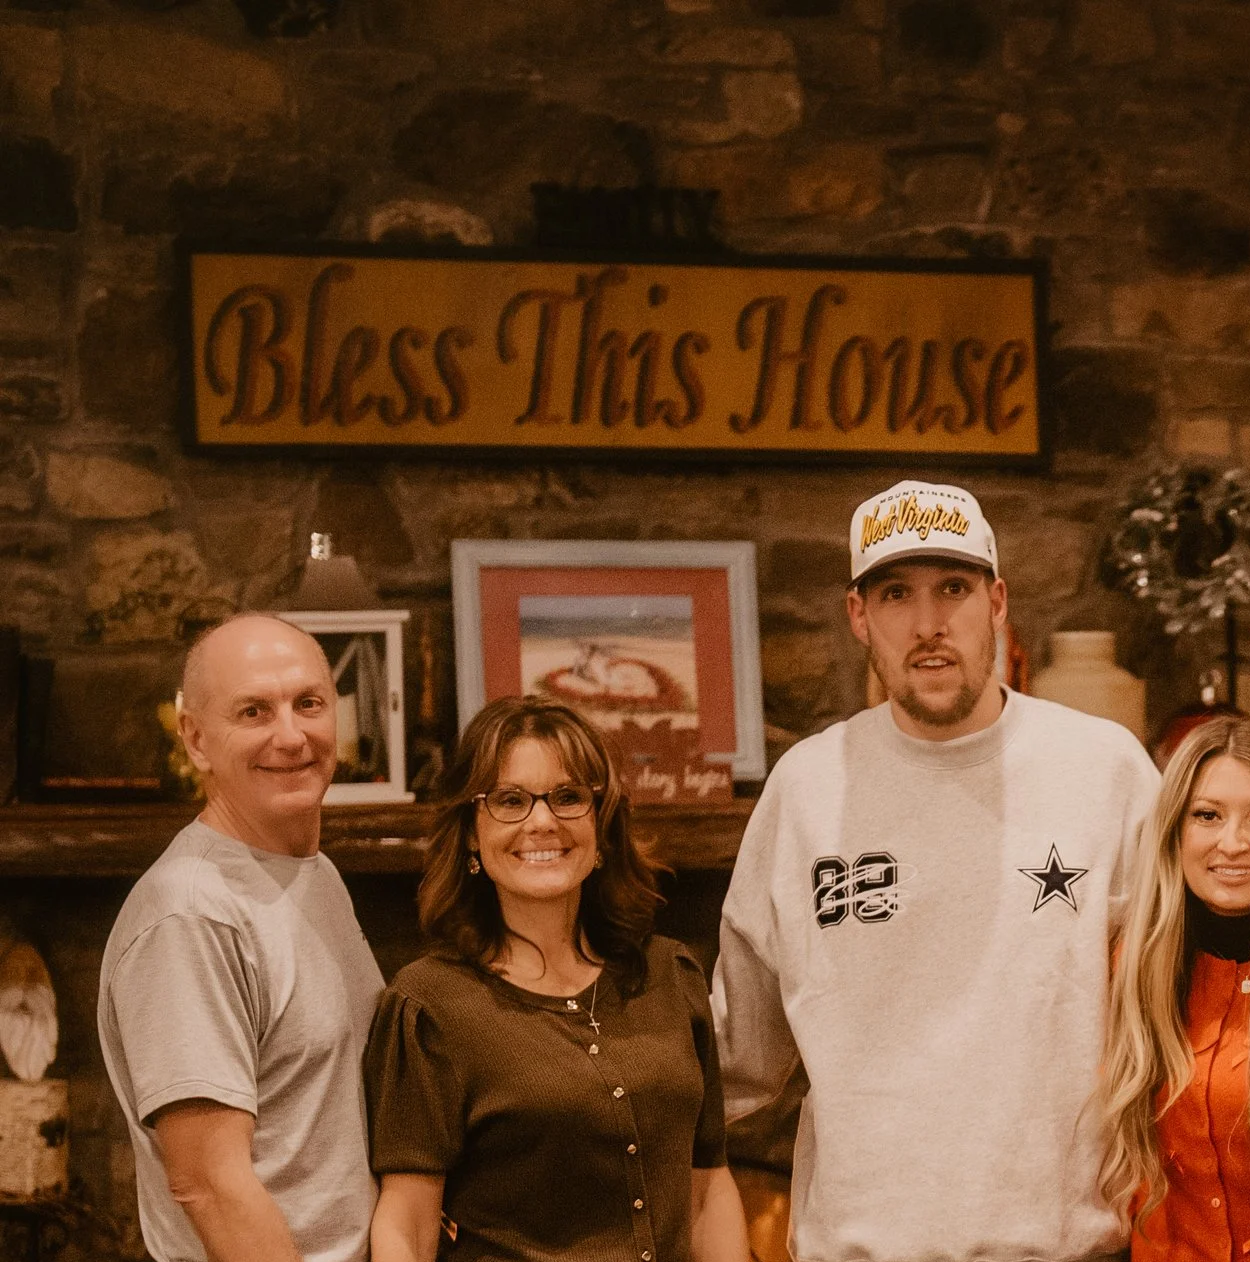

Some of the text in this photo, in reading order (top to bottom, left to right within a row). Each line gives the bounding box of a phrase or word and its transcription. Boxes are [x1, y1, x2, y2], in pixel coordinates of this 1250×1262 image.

[203, 263, 1029, 435] Bless This House
[860, 495, 970, 554] West Virginia
[879, 489, 967, 504] MOUNTAINEERS
[810, 851, 898, 930] 88
